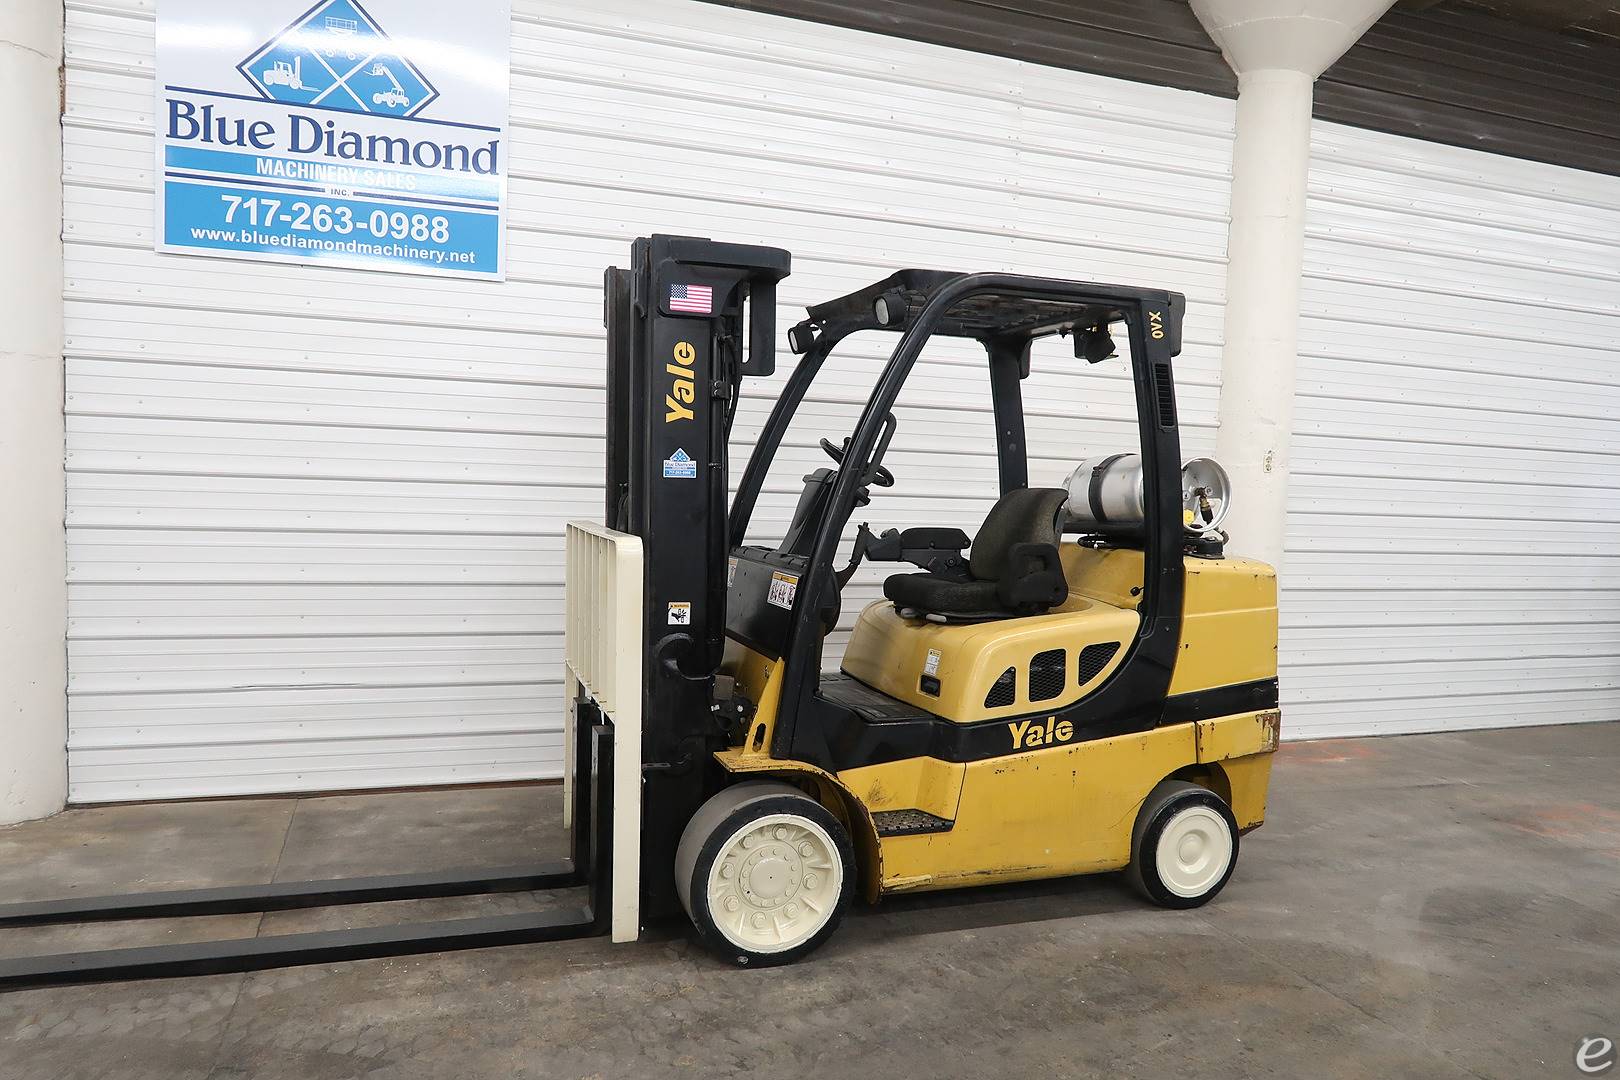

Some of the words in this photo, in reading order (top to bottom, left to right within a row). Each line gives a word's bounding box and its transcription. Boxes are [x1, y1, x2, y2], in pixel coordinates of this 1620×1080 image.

[165, 99, 275, 150] Blue
[287, 114, 500, 176] Diamond
[256, 157, 358, 182] MACHINERY
[363, 169, 417, 191] SALES
[330, 188, 351, 197] INC.
[221, 194, 450, 243] 717-263-0988
[190, 226, 476, 264] www.bluediamondmachinery.net
[665, 341, 696, 423] Yale
[1008, 716, 1074, 750] Yale
